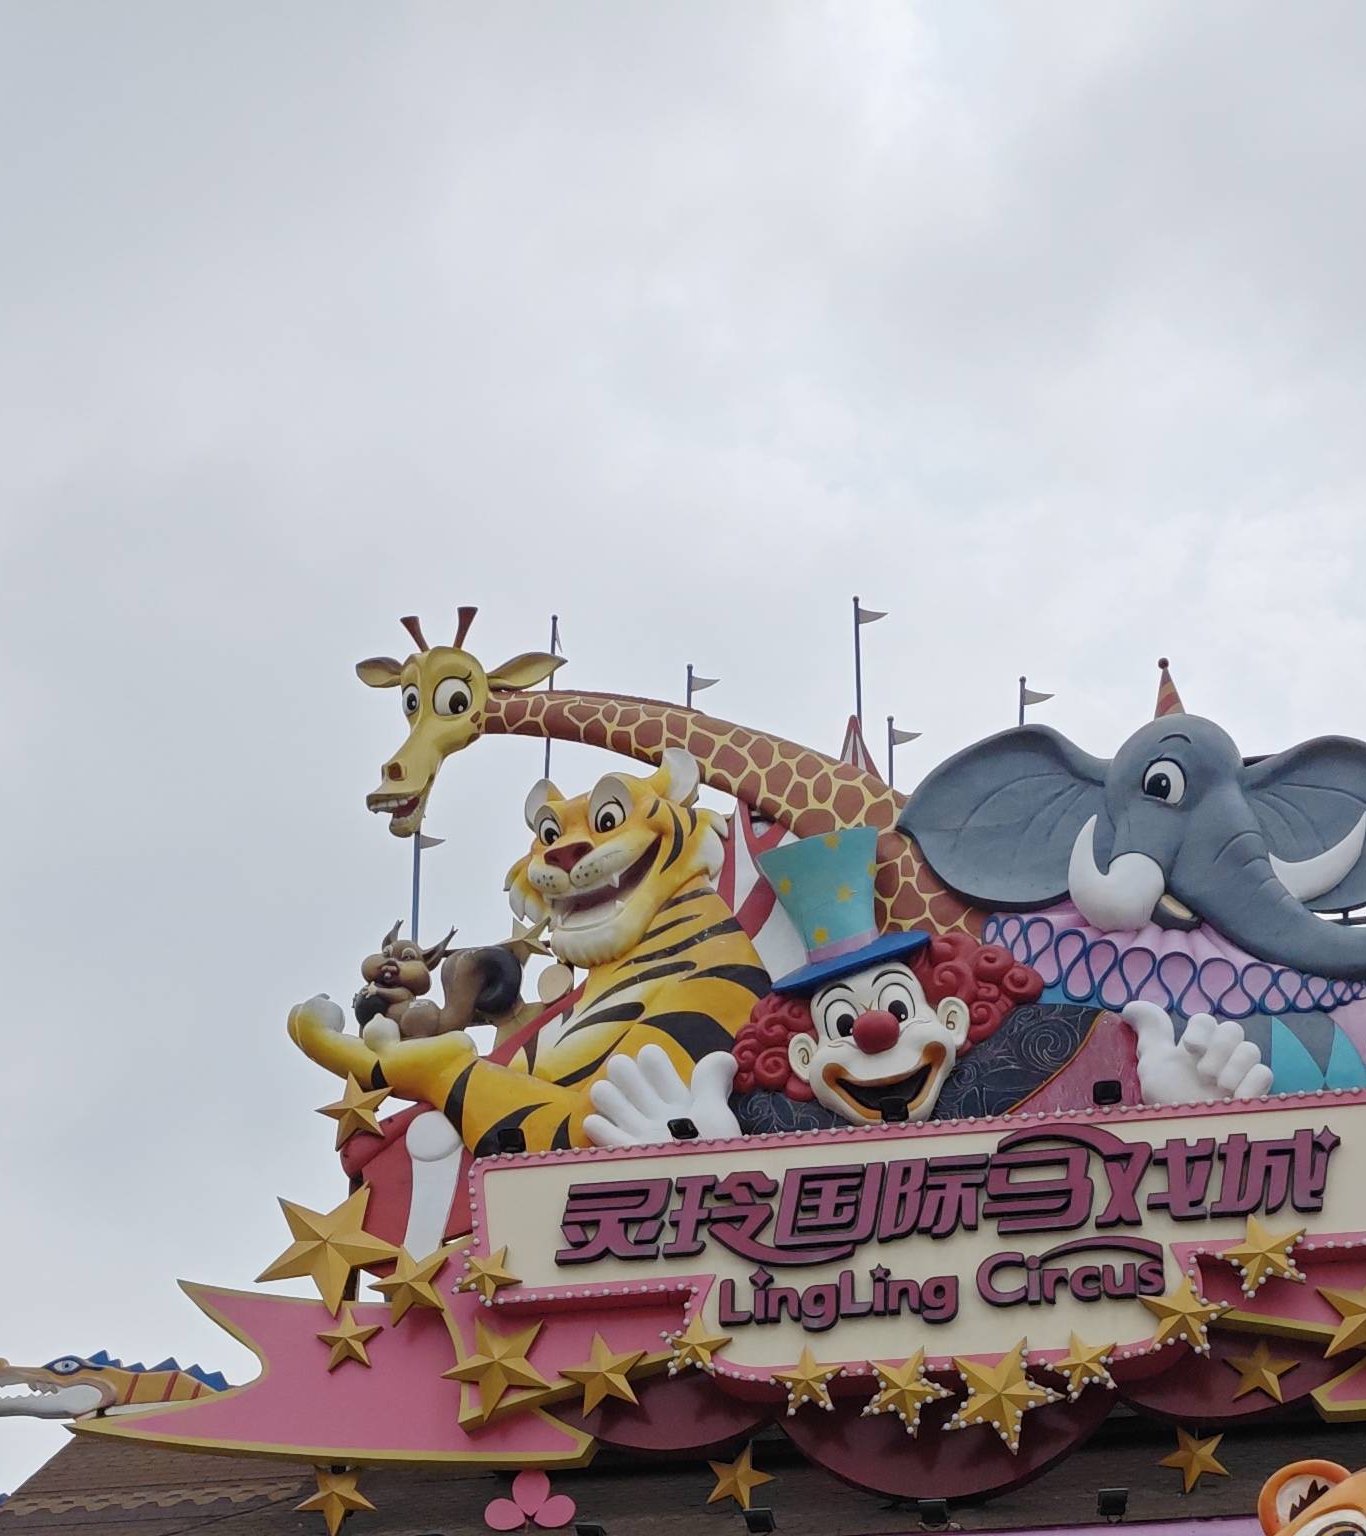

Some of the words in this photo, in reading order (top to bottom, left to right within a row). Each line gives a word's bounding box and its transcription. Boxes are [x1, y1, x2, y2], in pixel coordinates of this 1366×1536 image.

[555, 1124, 1341, 1267] 灵玲国际马戏城
[718, 1263, 961, 1332] LingLing
[976, 1236, 1164, 1306] Circus
